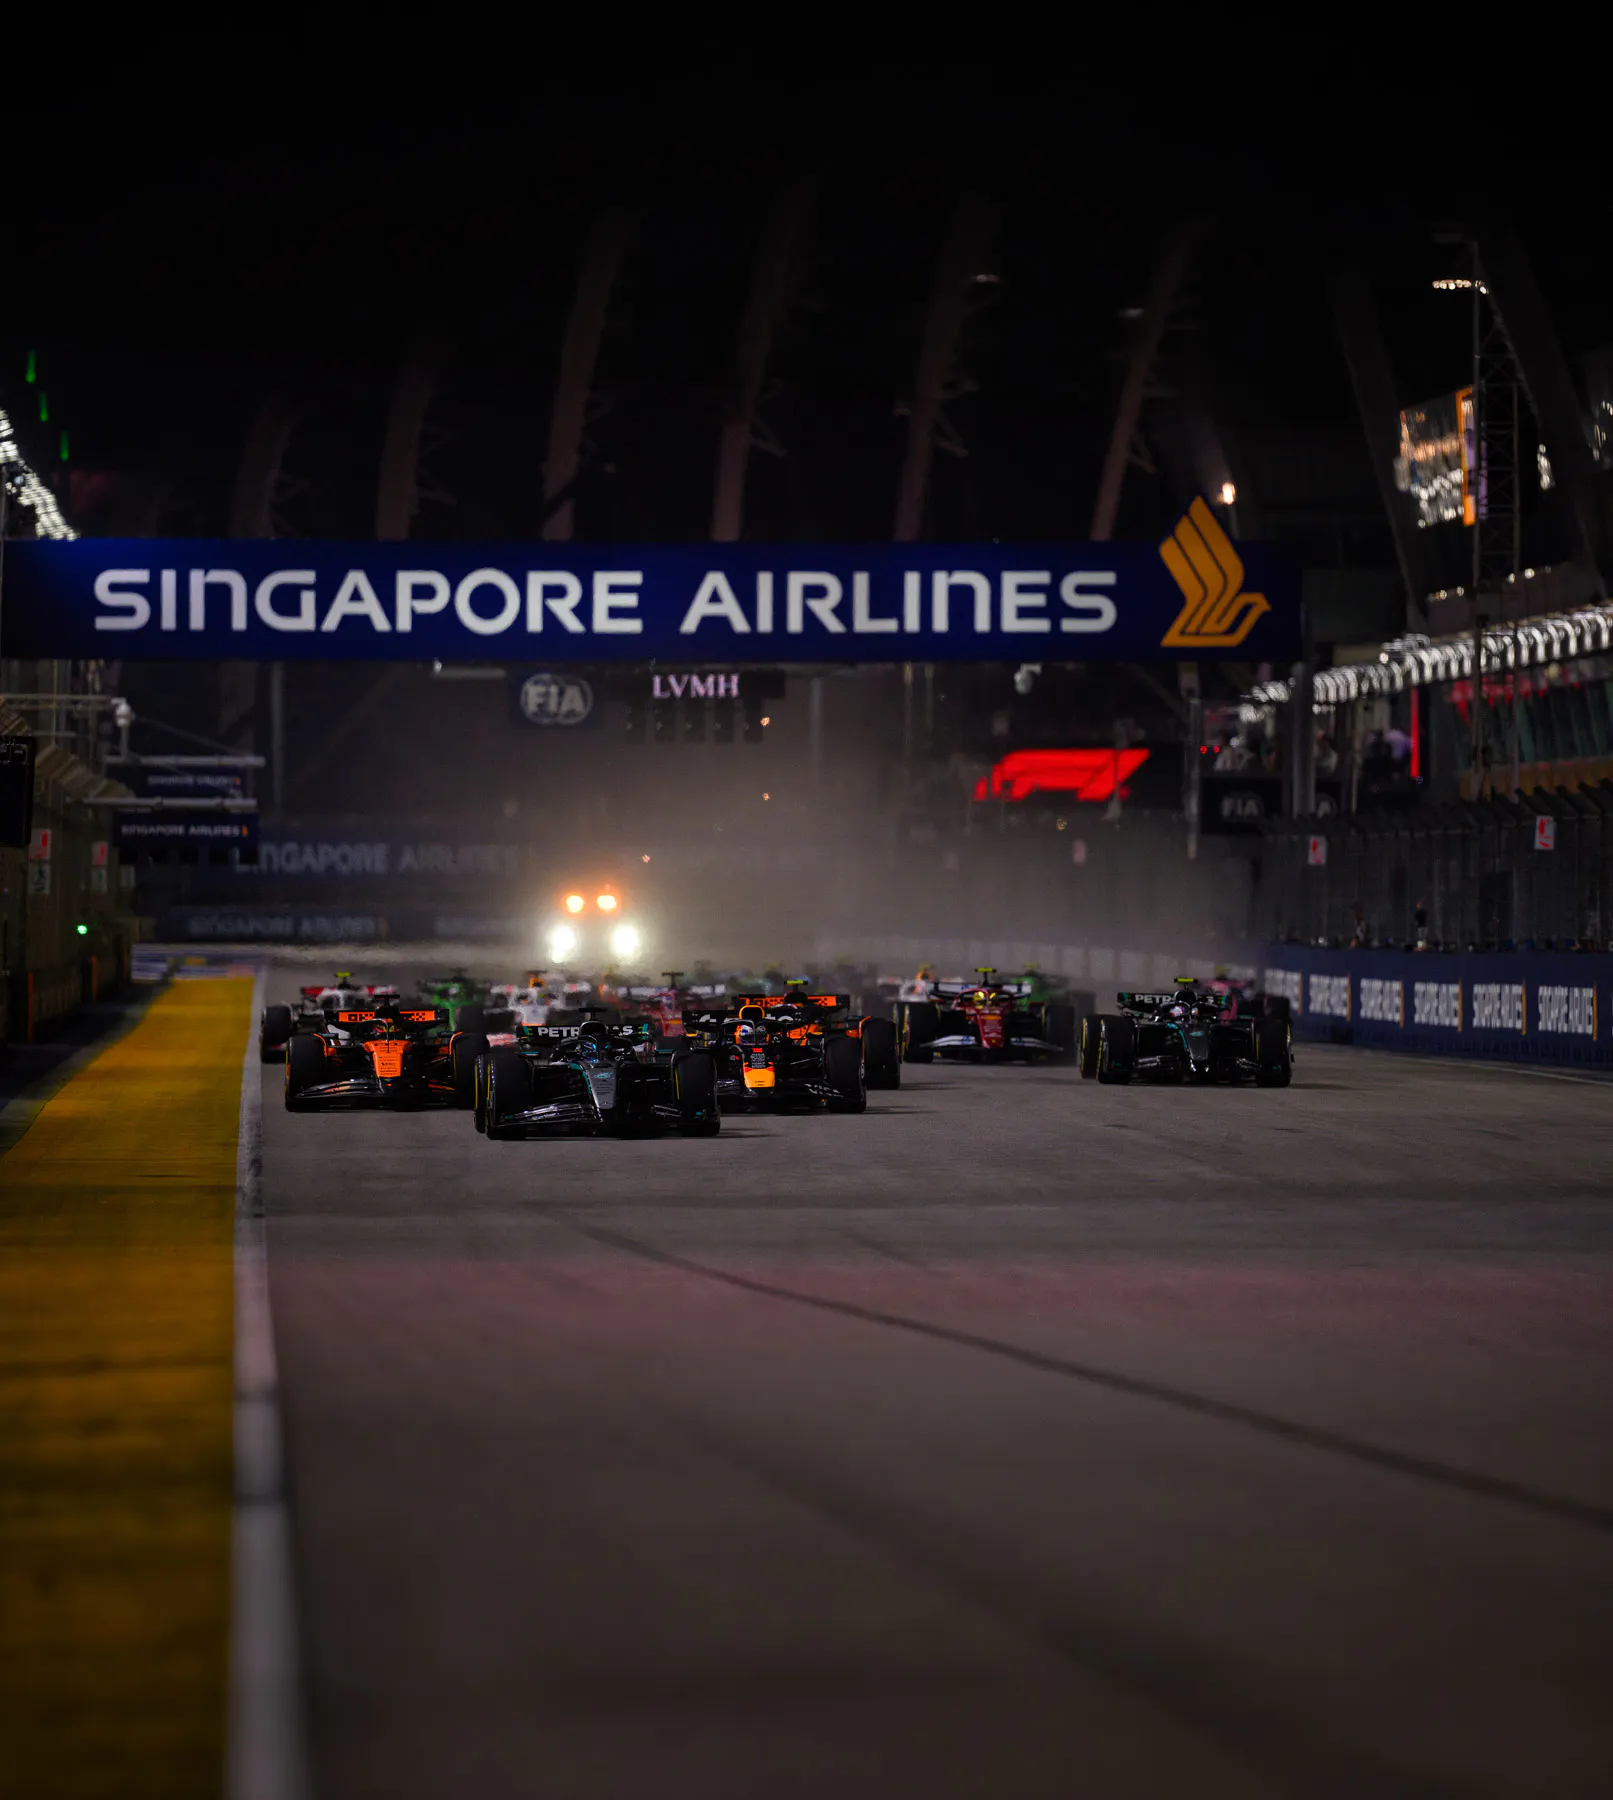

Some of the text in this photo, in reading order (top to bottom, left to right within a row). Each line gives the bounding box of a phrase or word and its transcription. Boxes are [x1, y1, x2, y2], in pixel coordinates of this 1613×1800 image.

[94, 568, 1118, 635] SINGAPORE AIRLINES
[526, 683, 586, 715] FIA
[652, 674, 740, 699] LVMH
[537, 1025, 634, 1038] PETRAS
